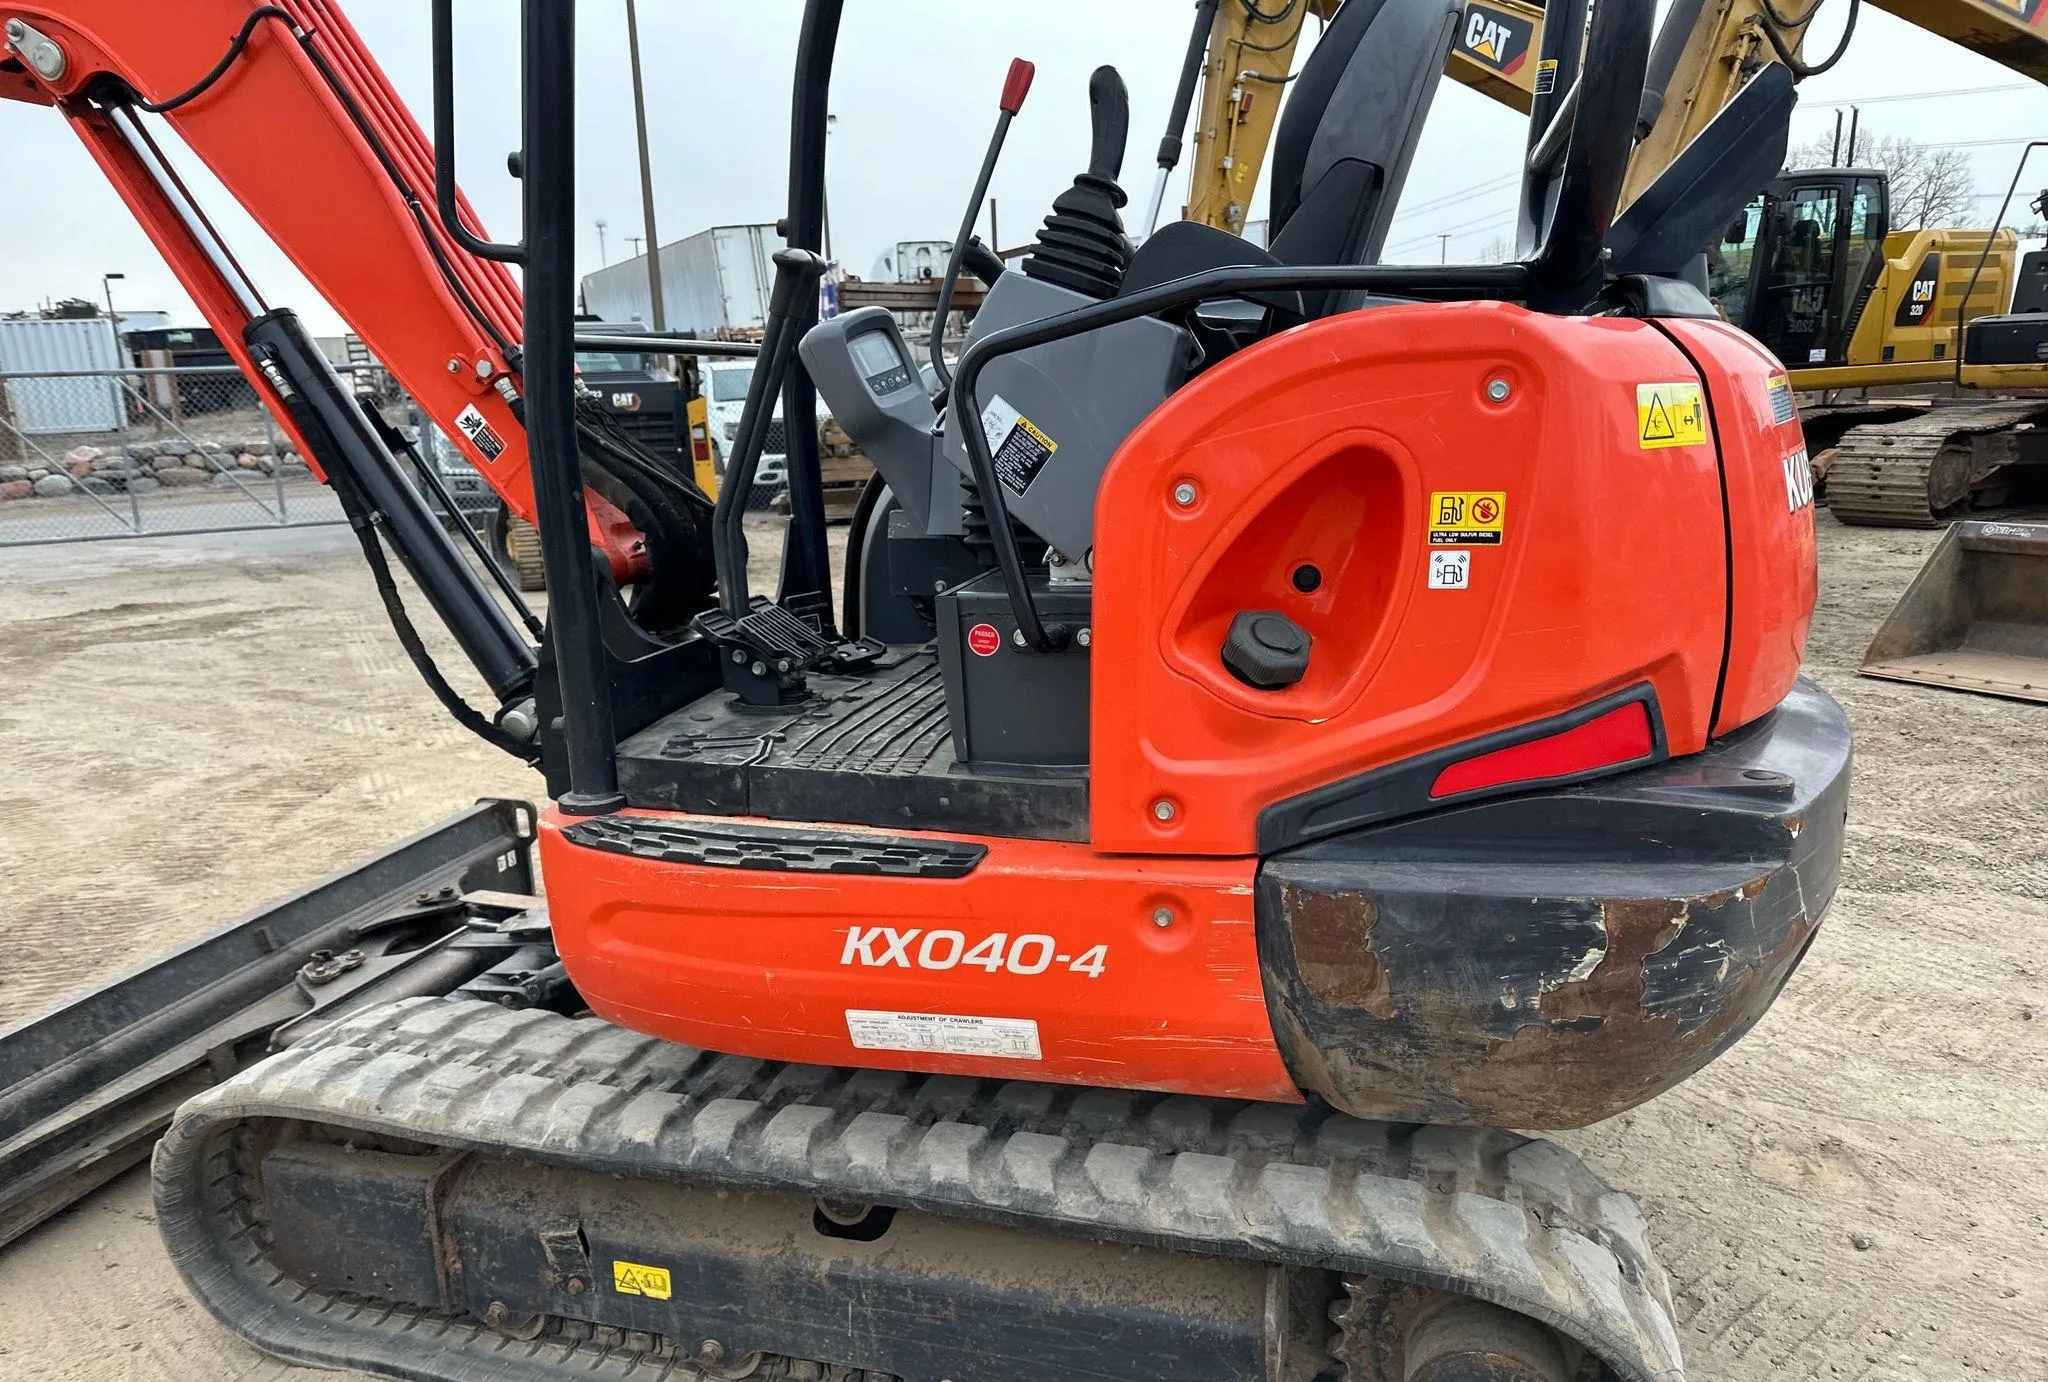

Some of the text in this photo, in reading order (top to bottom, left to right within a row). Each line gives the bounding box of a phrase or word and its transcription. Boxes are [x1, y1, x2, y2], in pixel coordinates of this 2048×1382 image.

[1465, 12, 1512, 63] CAT
[1913, 281, 1936, 301] CAT
[1910, 305, 1924, 316] 320
[612, 392, 634, 407] CAT
[1028, 427, 1053, 449] CAUTION
[840, 926, 1109, 978] KX040-4
[897, 1015, 937, 1023] ADJUSTMENT
[949, 1017, 984, 1025] CRAWLERS
